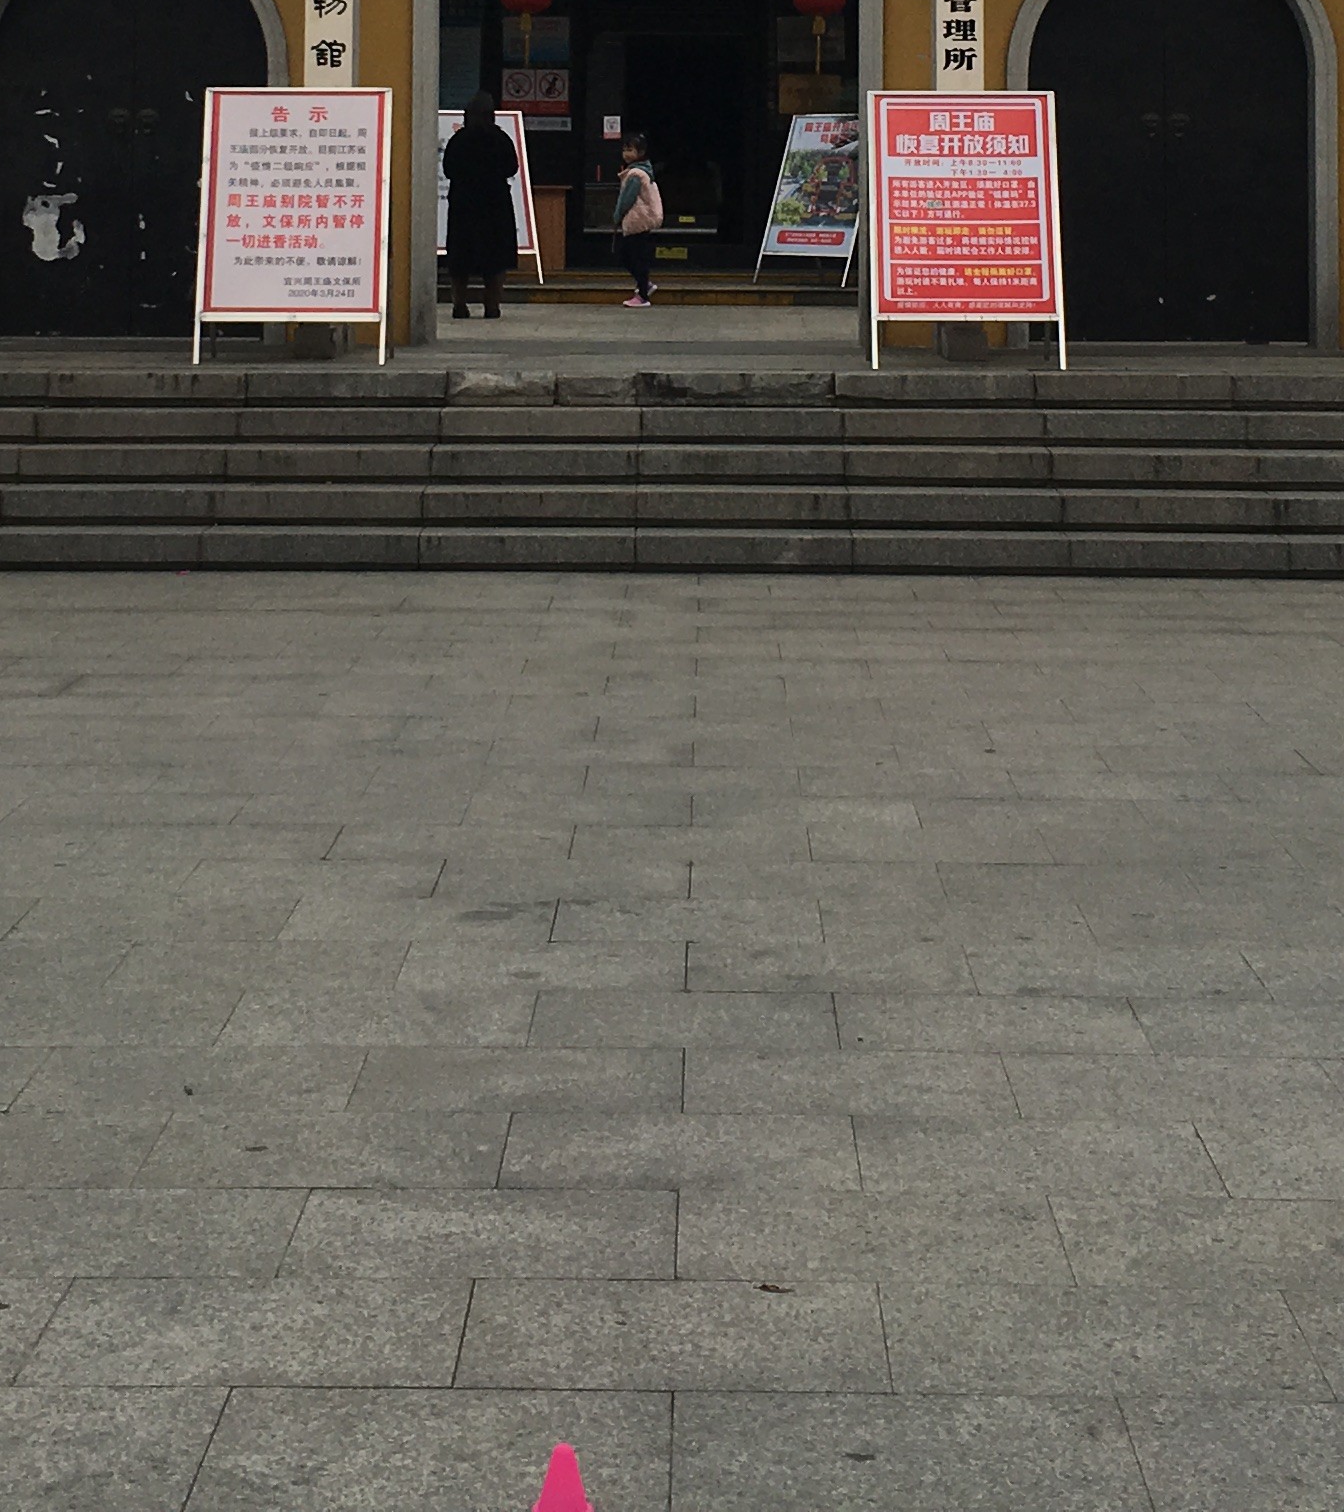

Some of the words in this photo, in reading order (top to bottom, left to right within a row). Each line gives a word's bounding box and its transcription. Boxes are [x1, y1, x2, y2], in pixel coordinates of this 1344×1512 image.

[929, 111, 996, 133] 周王庙
[896, 134, 1030, 155] 恢复开放须知
[227, 193, 366, 208] 周王庙别院暂不开
[226, 213, 366, 229] 放，文保所内暂停
[225, 234, 326, 249] 一切进香活动。
[287, 289, 356, 298] 2020年3月24日
